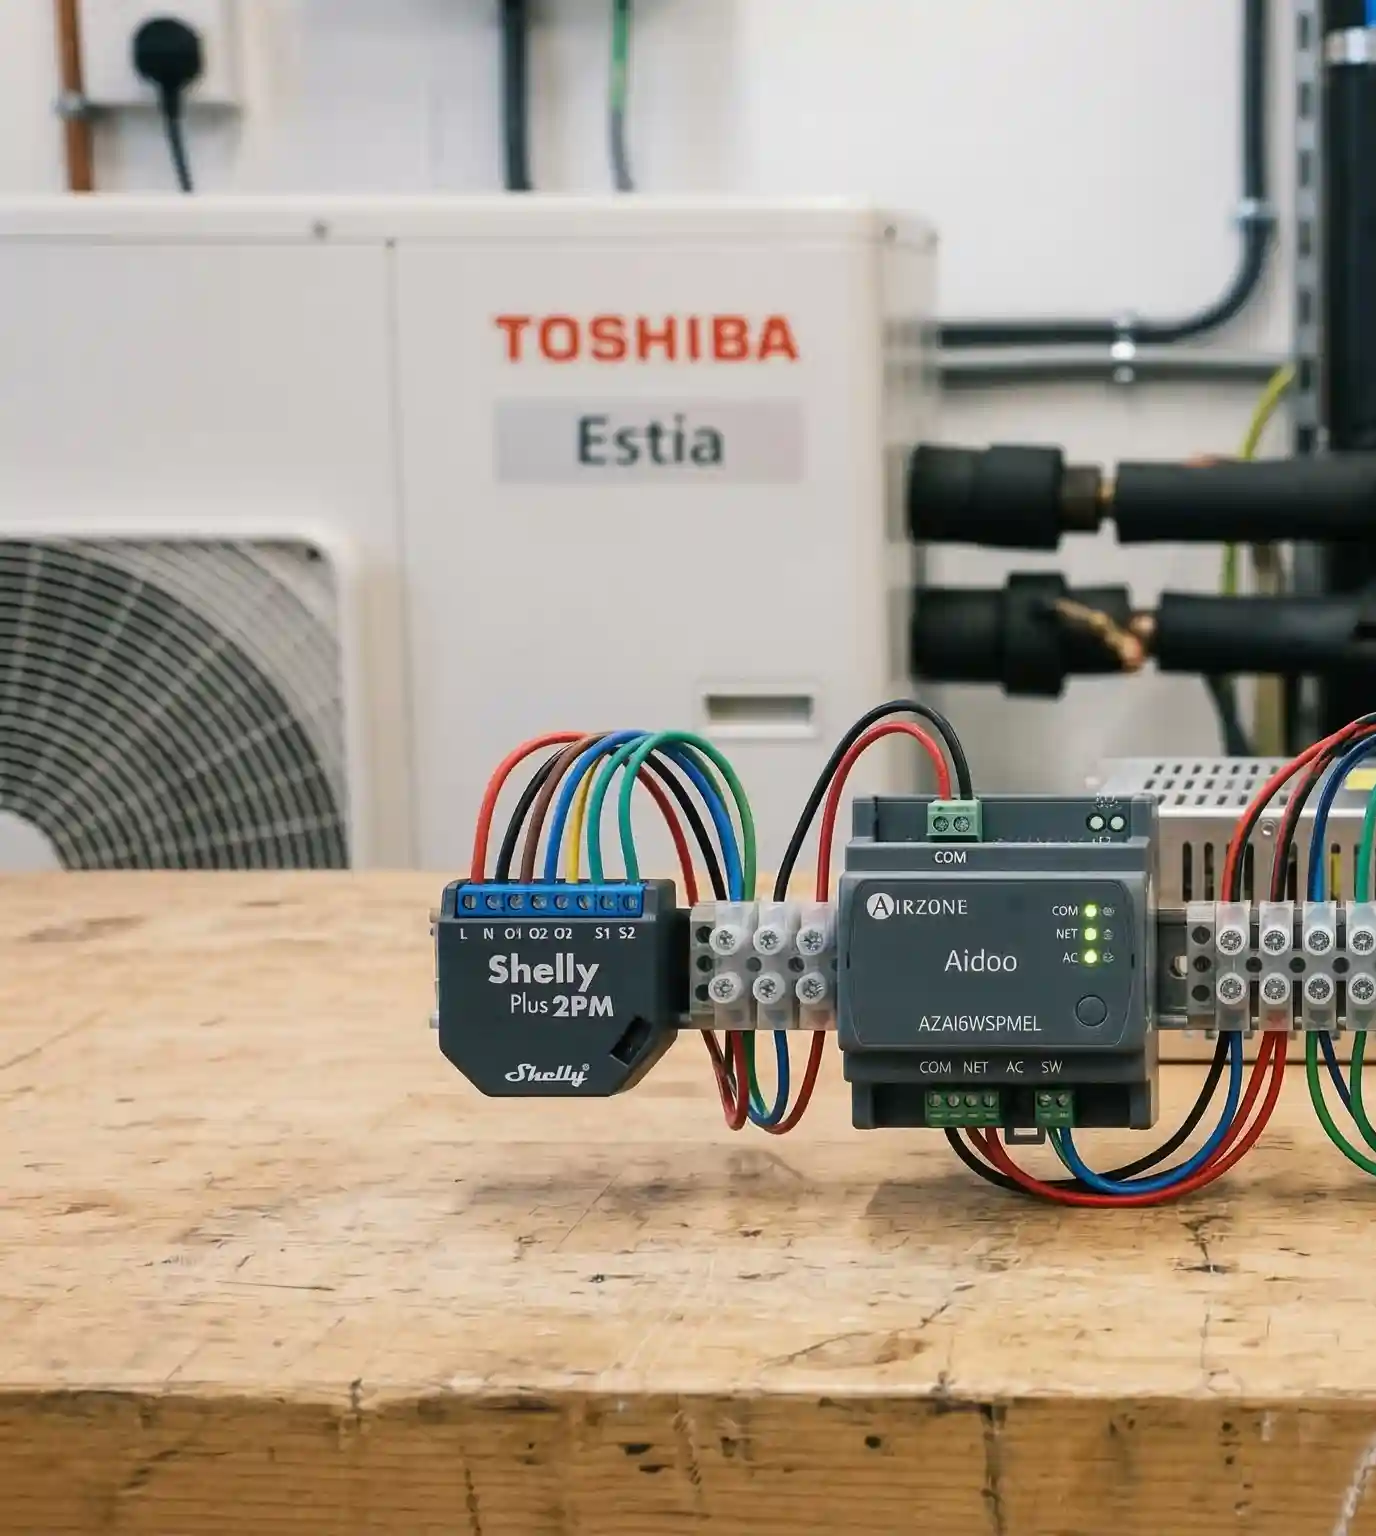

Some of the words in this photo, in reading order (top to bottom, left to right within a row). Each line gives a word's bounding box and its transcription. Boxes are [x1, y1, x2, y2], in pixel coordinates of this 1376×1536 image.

[495, 315, 799, 363] TOSHIBA
[577, 413, 725, 466] Estia
[934, 851, 967, 864] COM
[1051, 905, 1079, 917] COM
[460, 928, 468, 940] L
[483, 928, 494, 940] N
[595, 926, 611, 940] S1
[618, 926, 637, 940] S2
[1056, 928, 1078, 940] NET
[944, 948, 1018, 973] Aidoo
[1062, 952, 1079, 964] AC
[488, 952, 600, 993] Shelly
[510, 991, 549, 1014] Plus
[552, 995, 614, 1017] 2PM
[918, 1015, 1042, 1032] AZAI6WSPMEL
[919, 1061, 952, 1075] COM
[963, 1061, 989, 1074] NET
[1006, 1061, 1024, 1074] AC
[1041, 1061, 1063, 1074] SW
